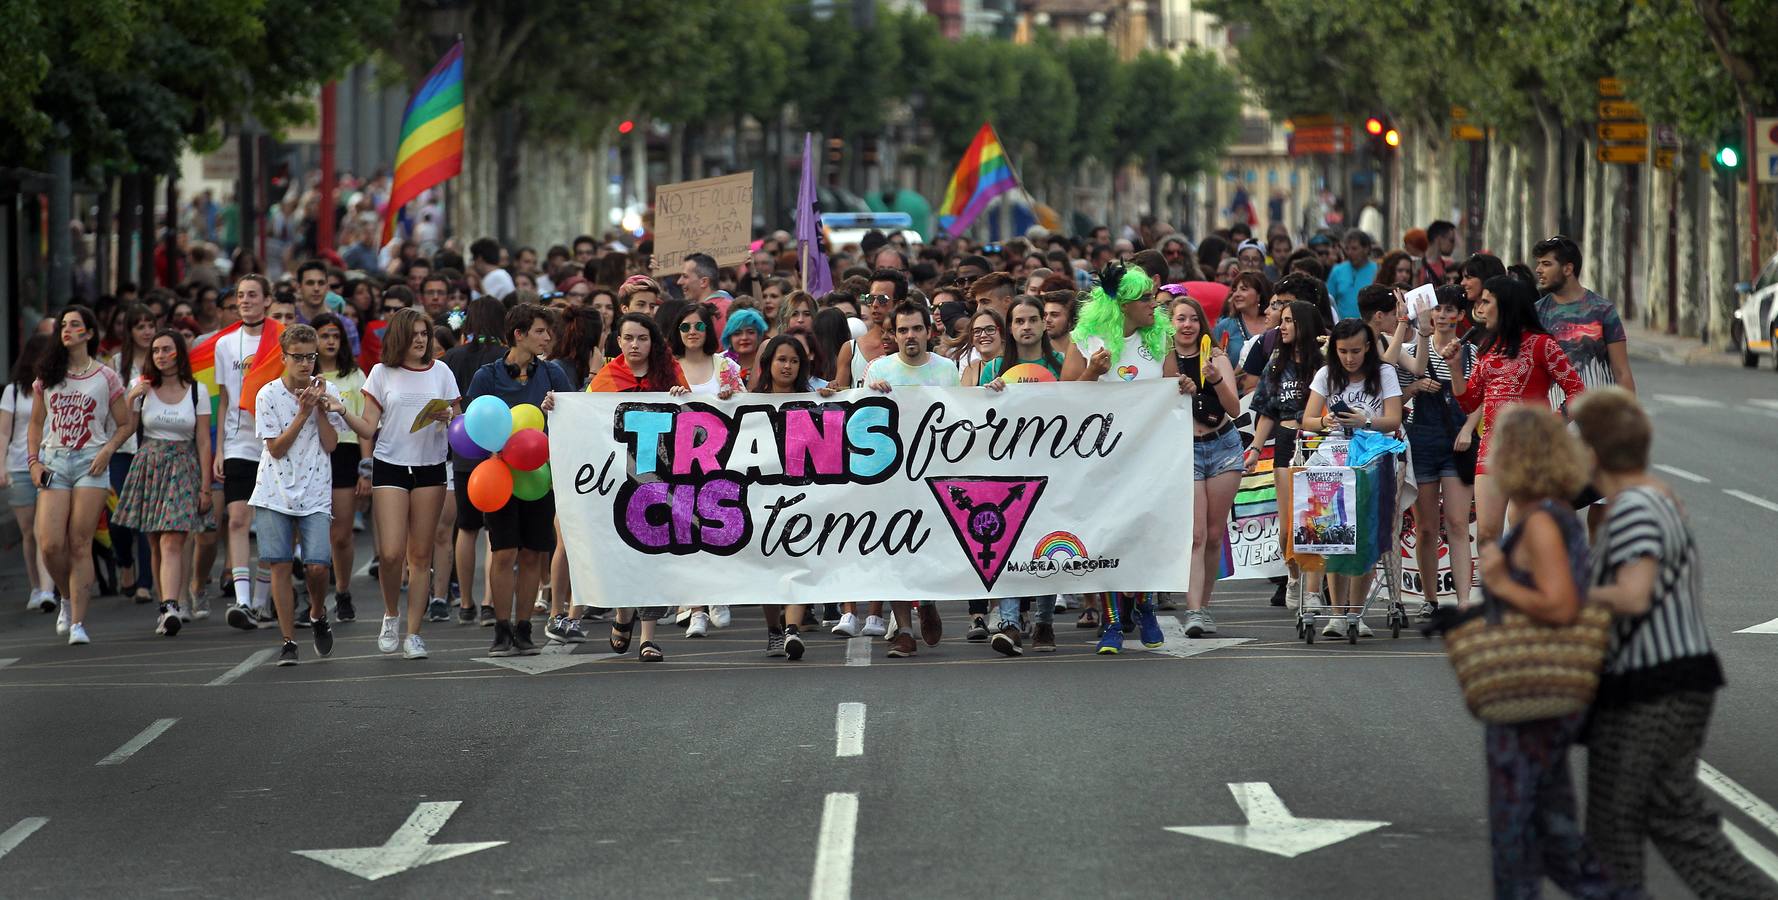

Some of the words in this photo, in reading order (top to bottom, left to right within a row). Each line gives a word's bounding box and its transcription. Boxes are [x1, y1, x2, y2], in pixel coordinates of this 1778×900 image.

[658, 192, 683, 216] NO
[664, 212, 701, 231] TRAS
[718, 207, 737, 220] LA
[678, 220, 742, 241] MASCARA
[1280, 389, 1303, 403] SAFE
[575, 450, 617, 496] el
[1007, 560, 1057, 572] MAREA
